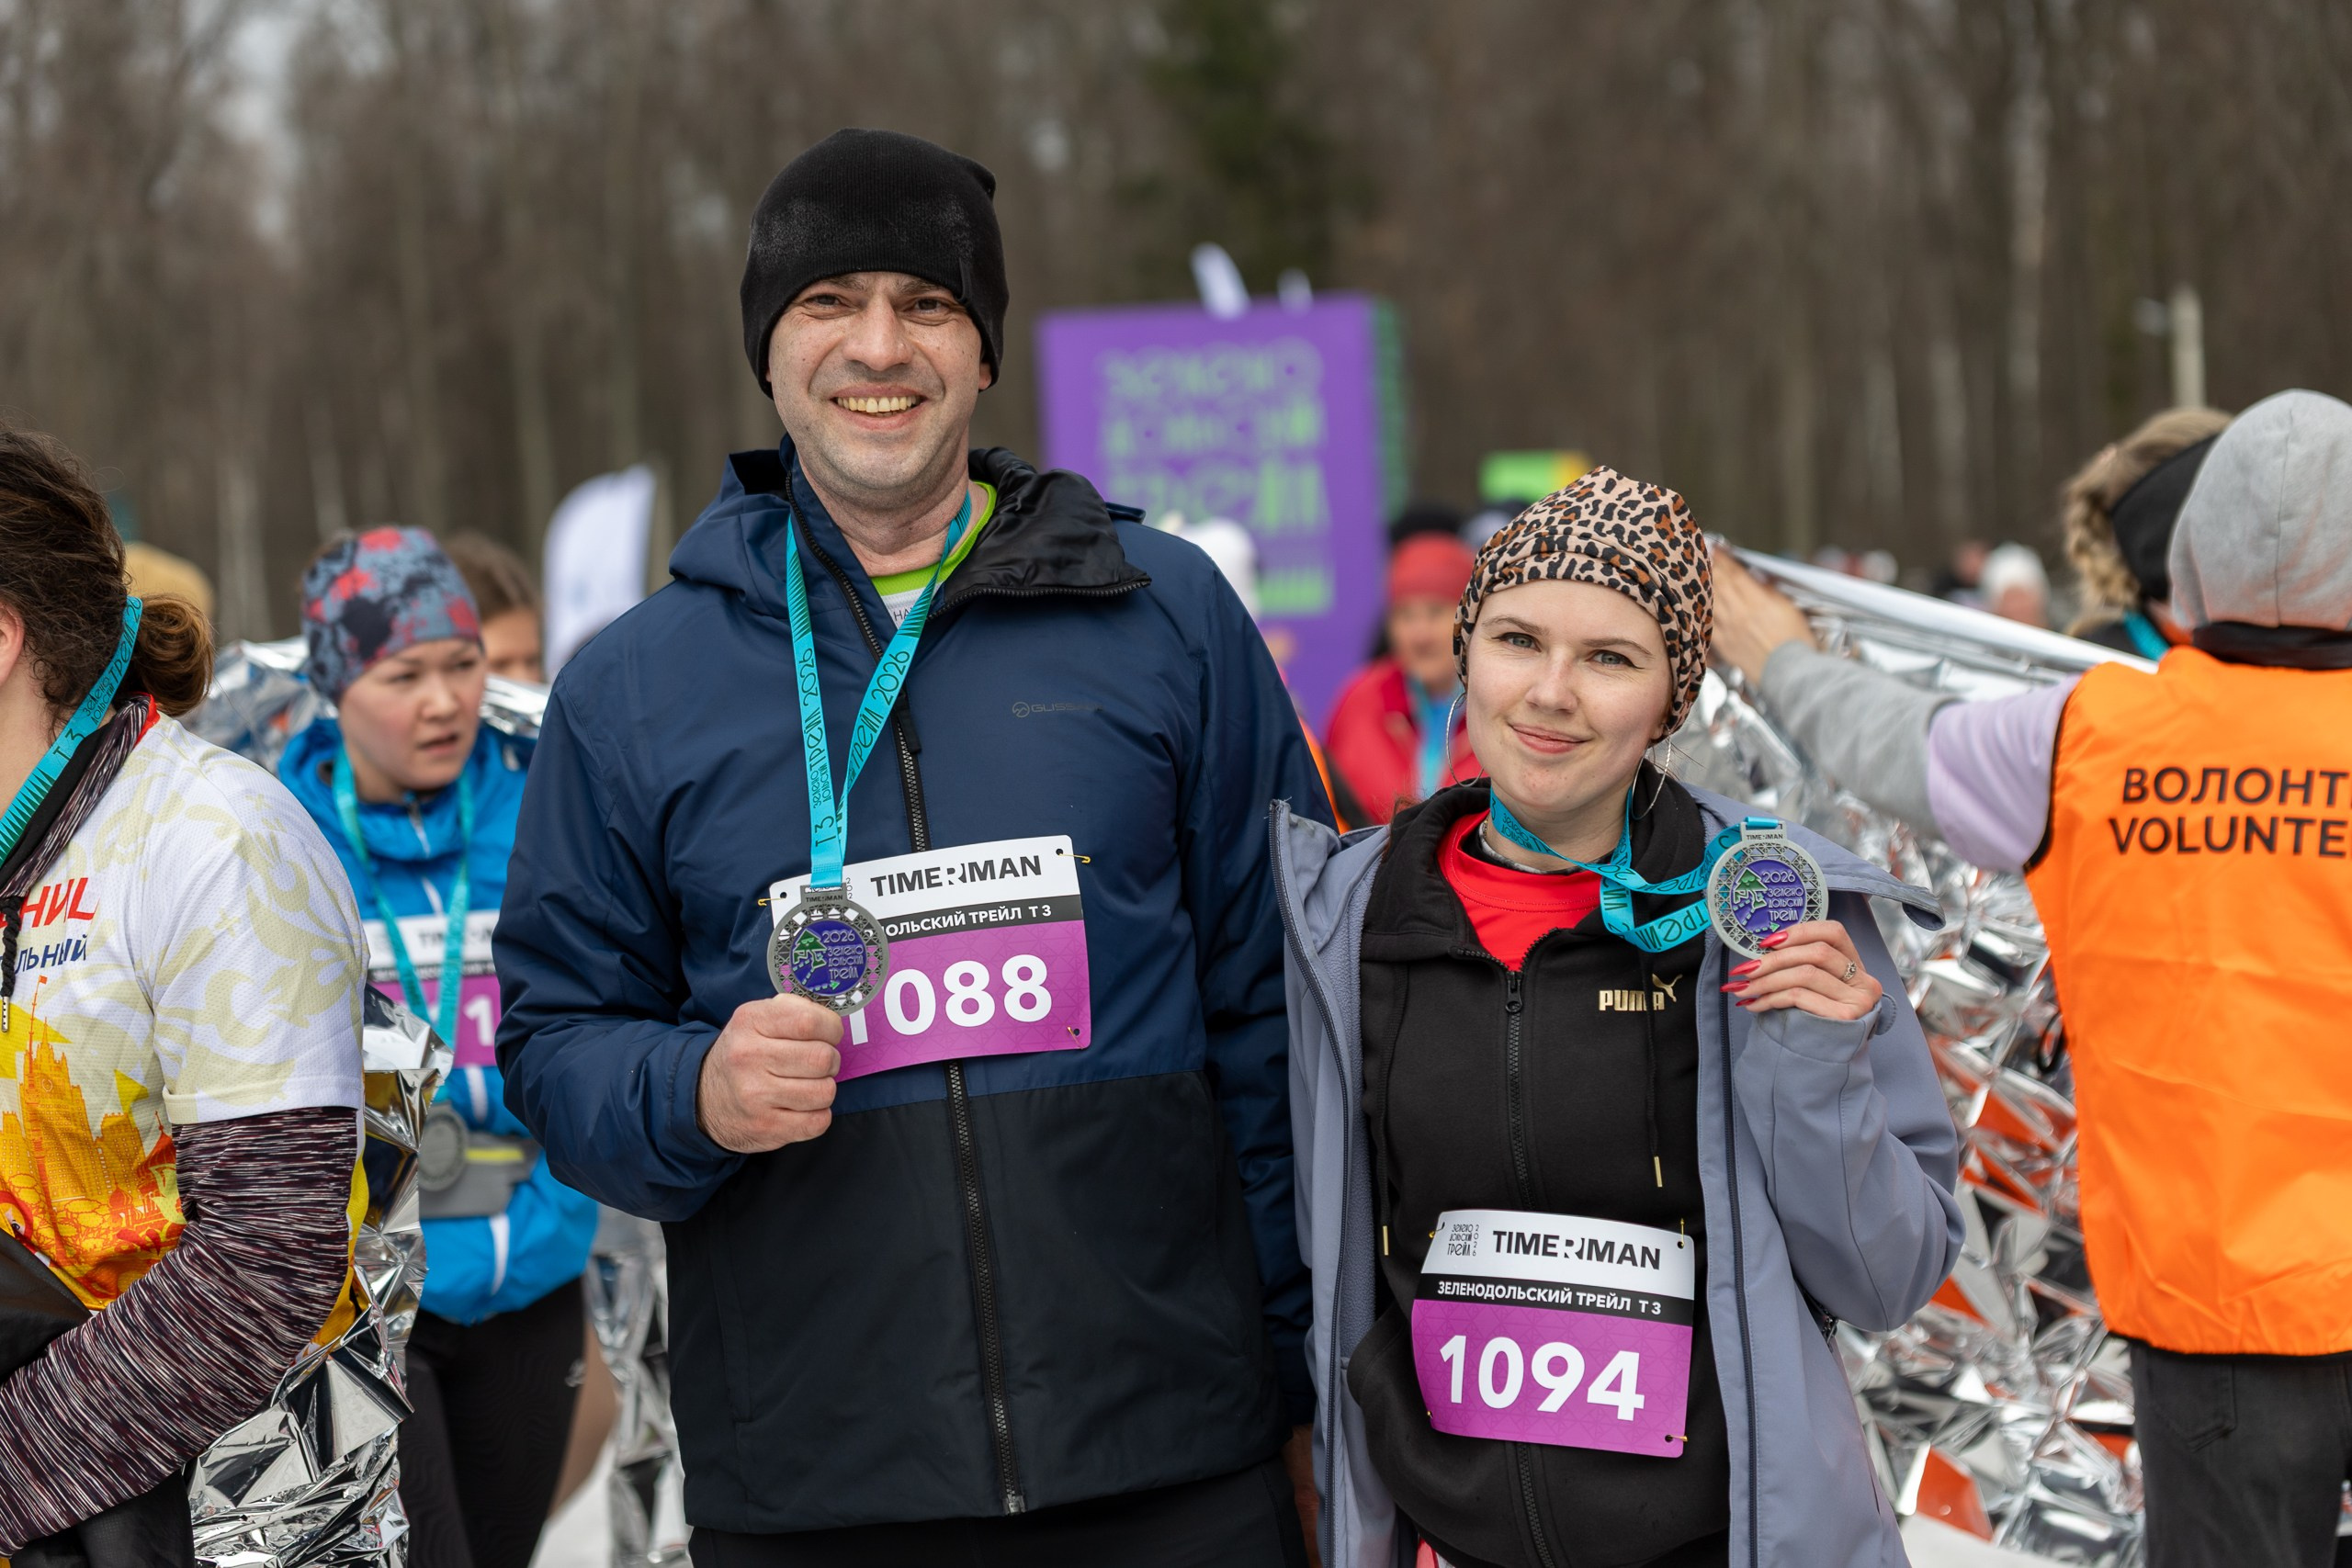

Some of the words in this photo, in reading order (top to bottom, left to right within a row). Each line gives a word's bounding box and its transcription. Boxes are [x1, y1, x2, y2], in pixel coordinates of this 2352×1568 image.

[798, 648, 819, 706] 2026
[871, 650, 910, 706] 2026
[1031, 702, 1103, 714] GLISS
[2121, 766, 2352, 808] ВОЛОНТ
[2108, 815, 2352, 858] VOLUNTE
[1762, 871, 1796, 884] 2026
[821, 930, 856, 943] 2026
[882, 908, 967, 939] ОЛЬСКИЙ
[968, 906, 1023, 931] ТРЕЙЛ
[1042, 904, 1053, 918] 3
[848, 953, 1053, 1046] 1088
[1599, 989, 1666, 1012] PUMA
[1437, 1280, 1573, 1307] ЗЕЛЕНОДОЛЬСКИЙ
[1576, 1291, 1632, 1312] ТРЕЙЛ
[1651, 1302, 1662, 1315] 3
[1439, 1335, 1645, 1422] 1094
